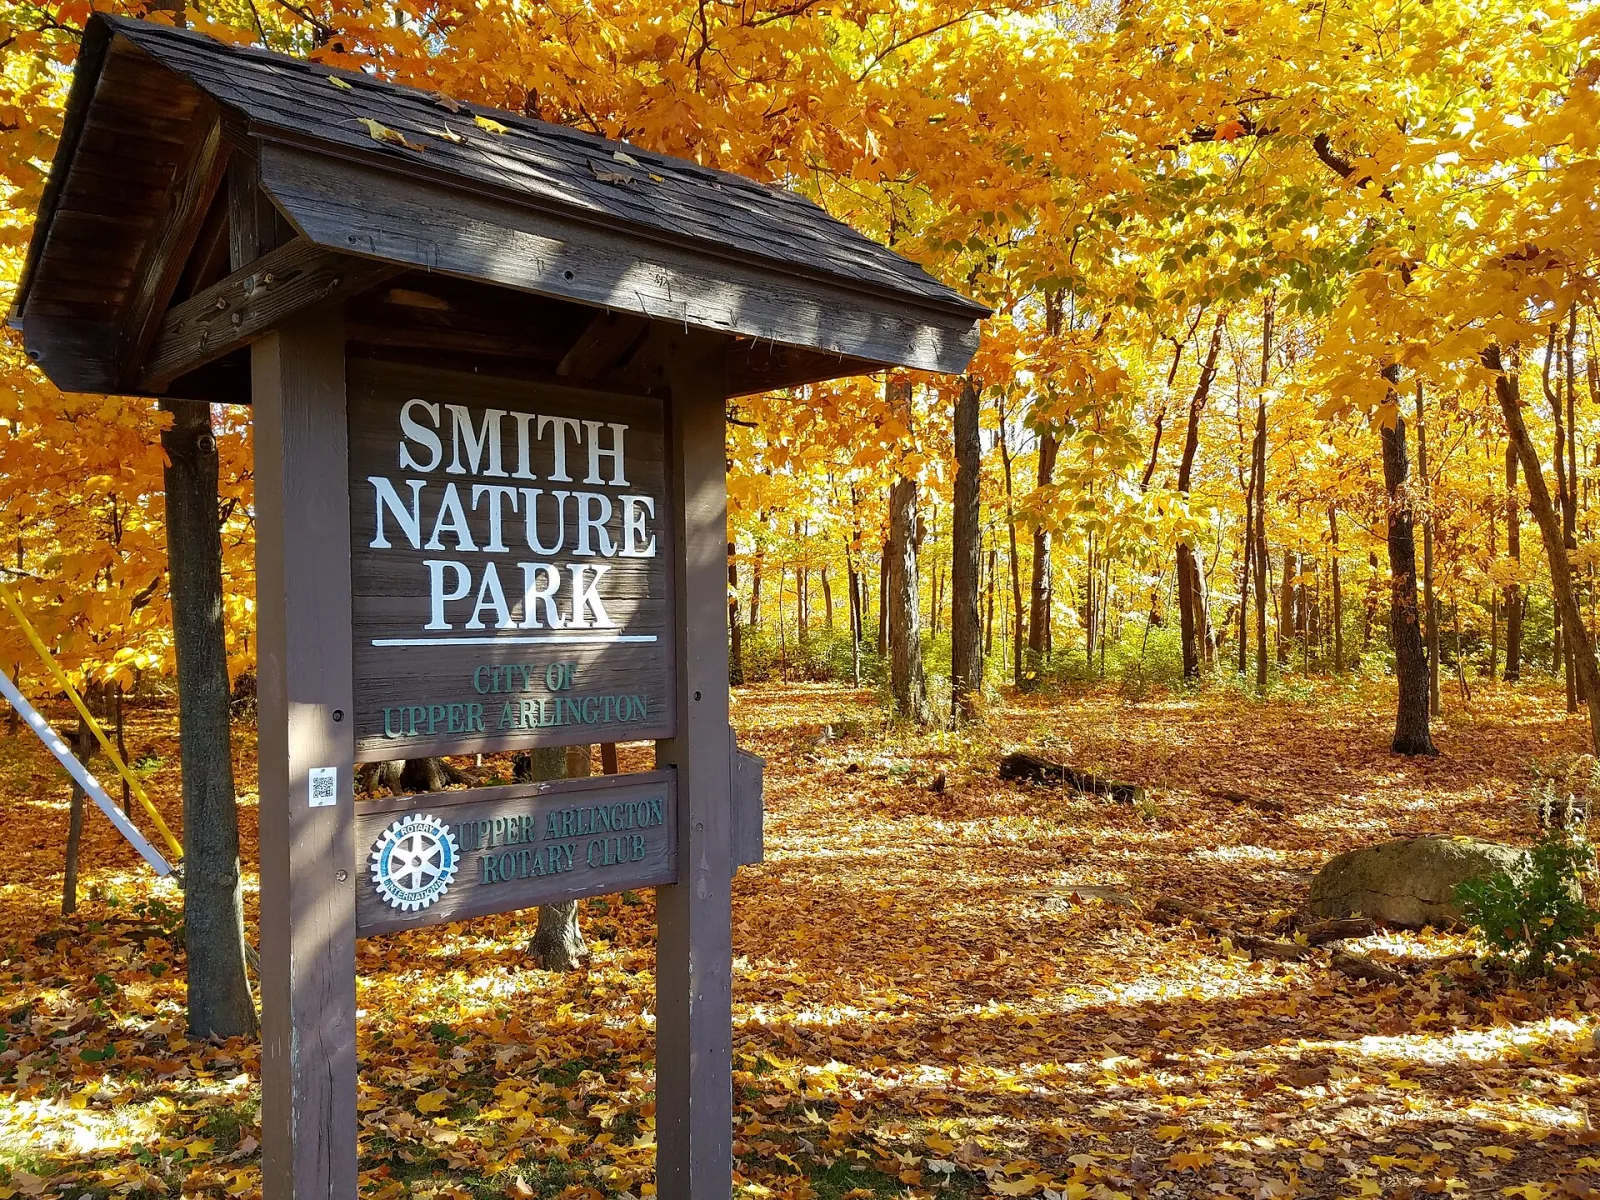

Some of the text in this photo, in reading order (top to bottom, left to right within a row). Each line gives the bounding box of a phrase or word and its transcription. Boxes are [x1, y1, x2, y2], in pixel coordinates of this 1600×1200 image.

[400, 399, 630, 486] SMITH
[367, 476, 656, 557] NATURE
[423, 559, 616, 630] PARK
[474, 661, 578, 695] CITY OF
[382, 694, 648, 739] UPPER ARLINGTON
[401, 823, 435, 835] ROTARY
[455, 799, 664, 852] UPPER ARLINGTON
[482, 834, 646, 885] ROTARY CLUB
[385, 873, 447, 901] INTERNATIONAL
